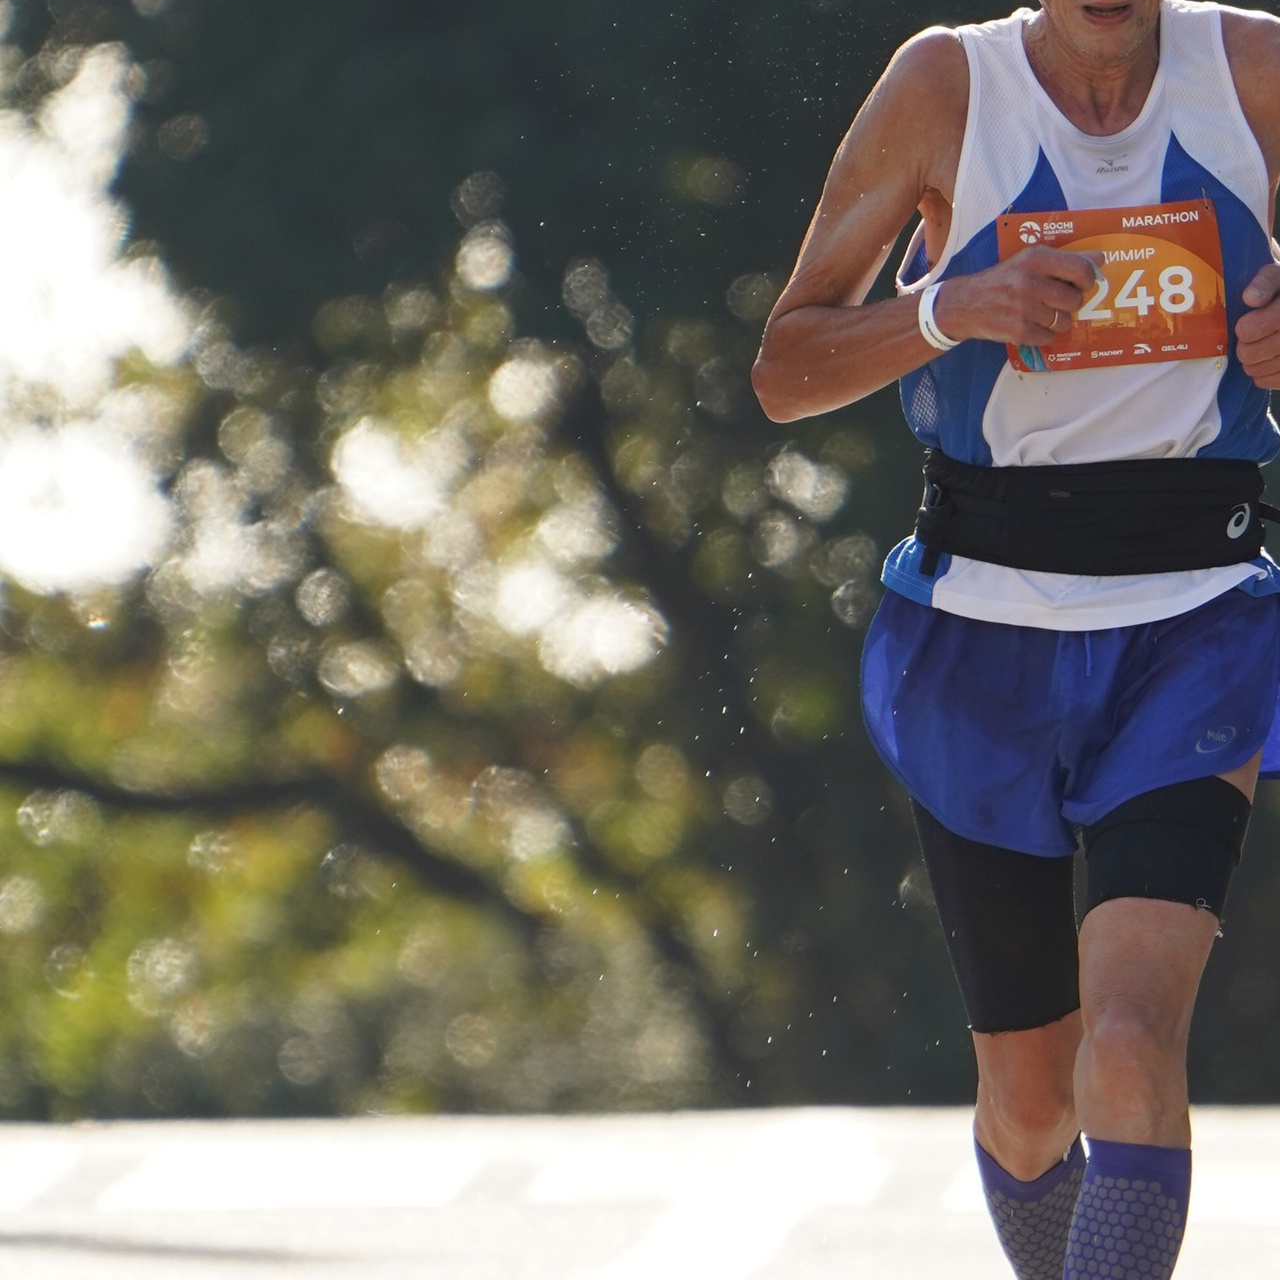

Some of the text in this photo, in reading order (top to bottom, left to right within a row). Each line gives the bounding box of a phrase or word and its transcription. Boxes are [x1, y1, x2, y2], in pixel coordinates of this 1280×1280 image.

[1043, 221, 1073, 230] SOCHI
[1122, 210, 1199, 228] MARATHON
[1078, 265, 1195, 321] 248
